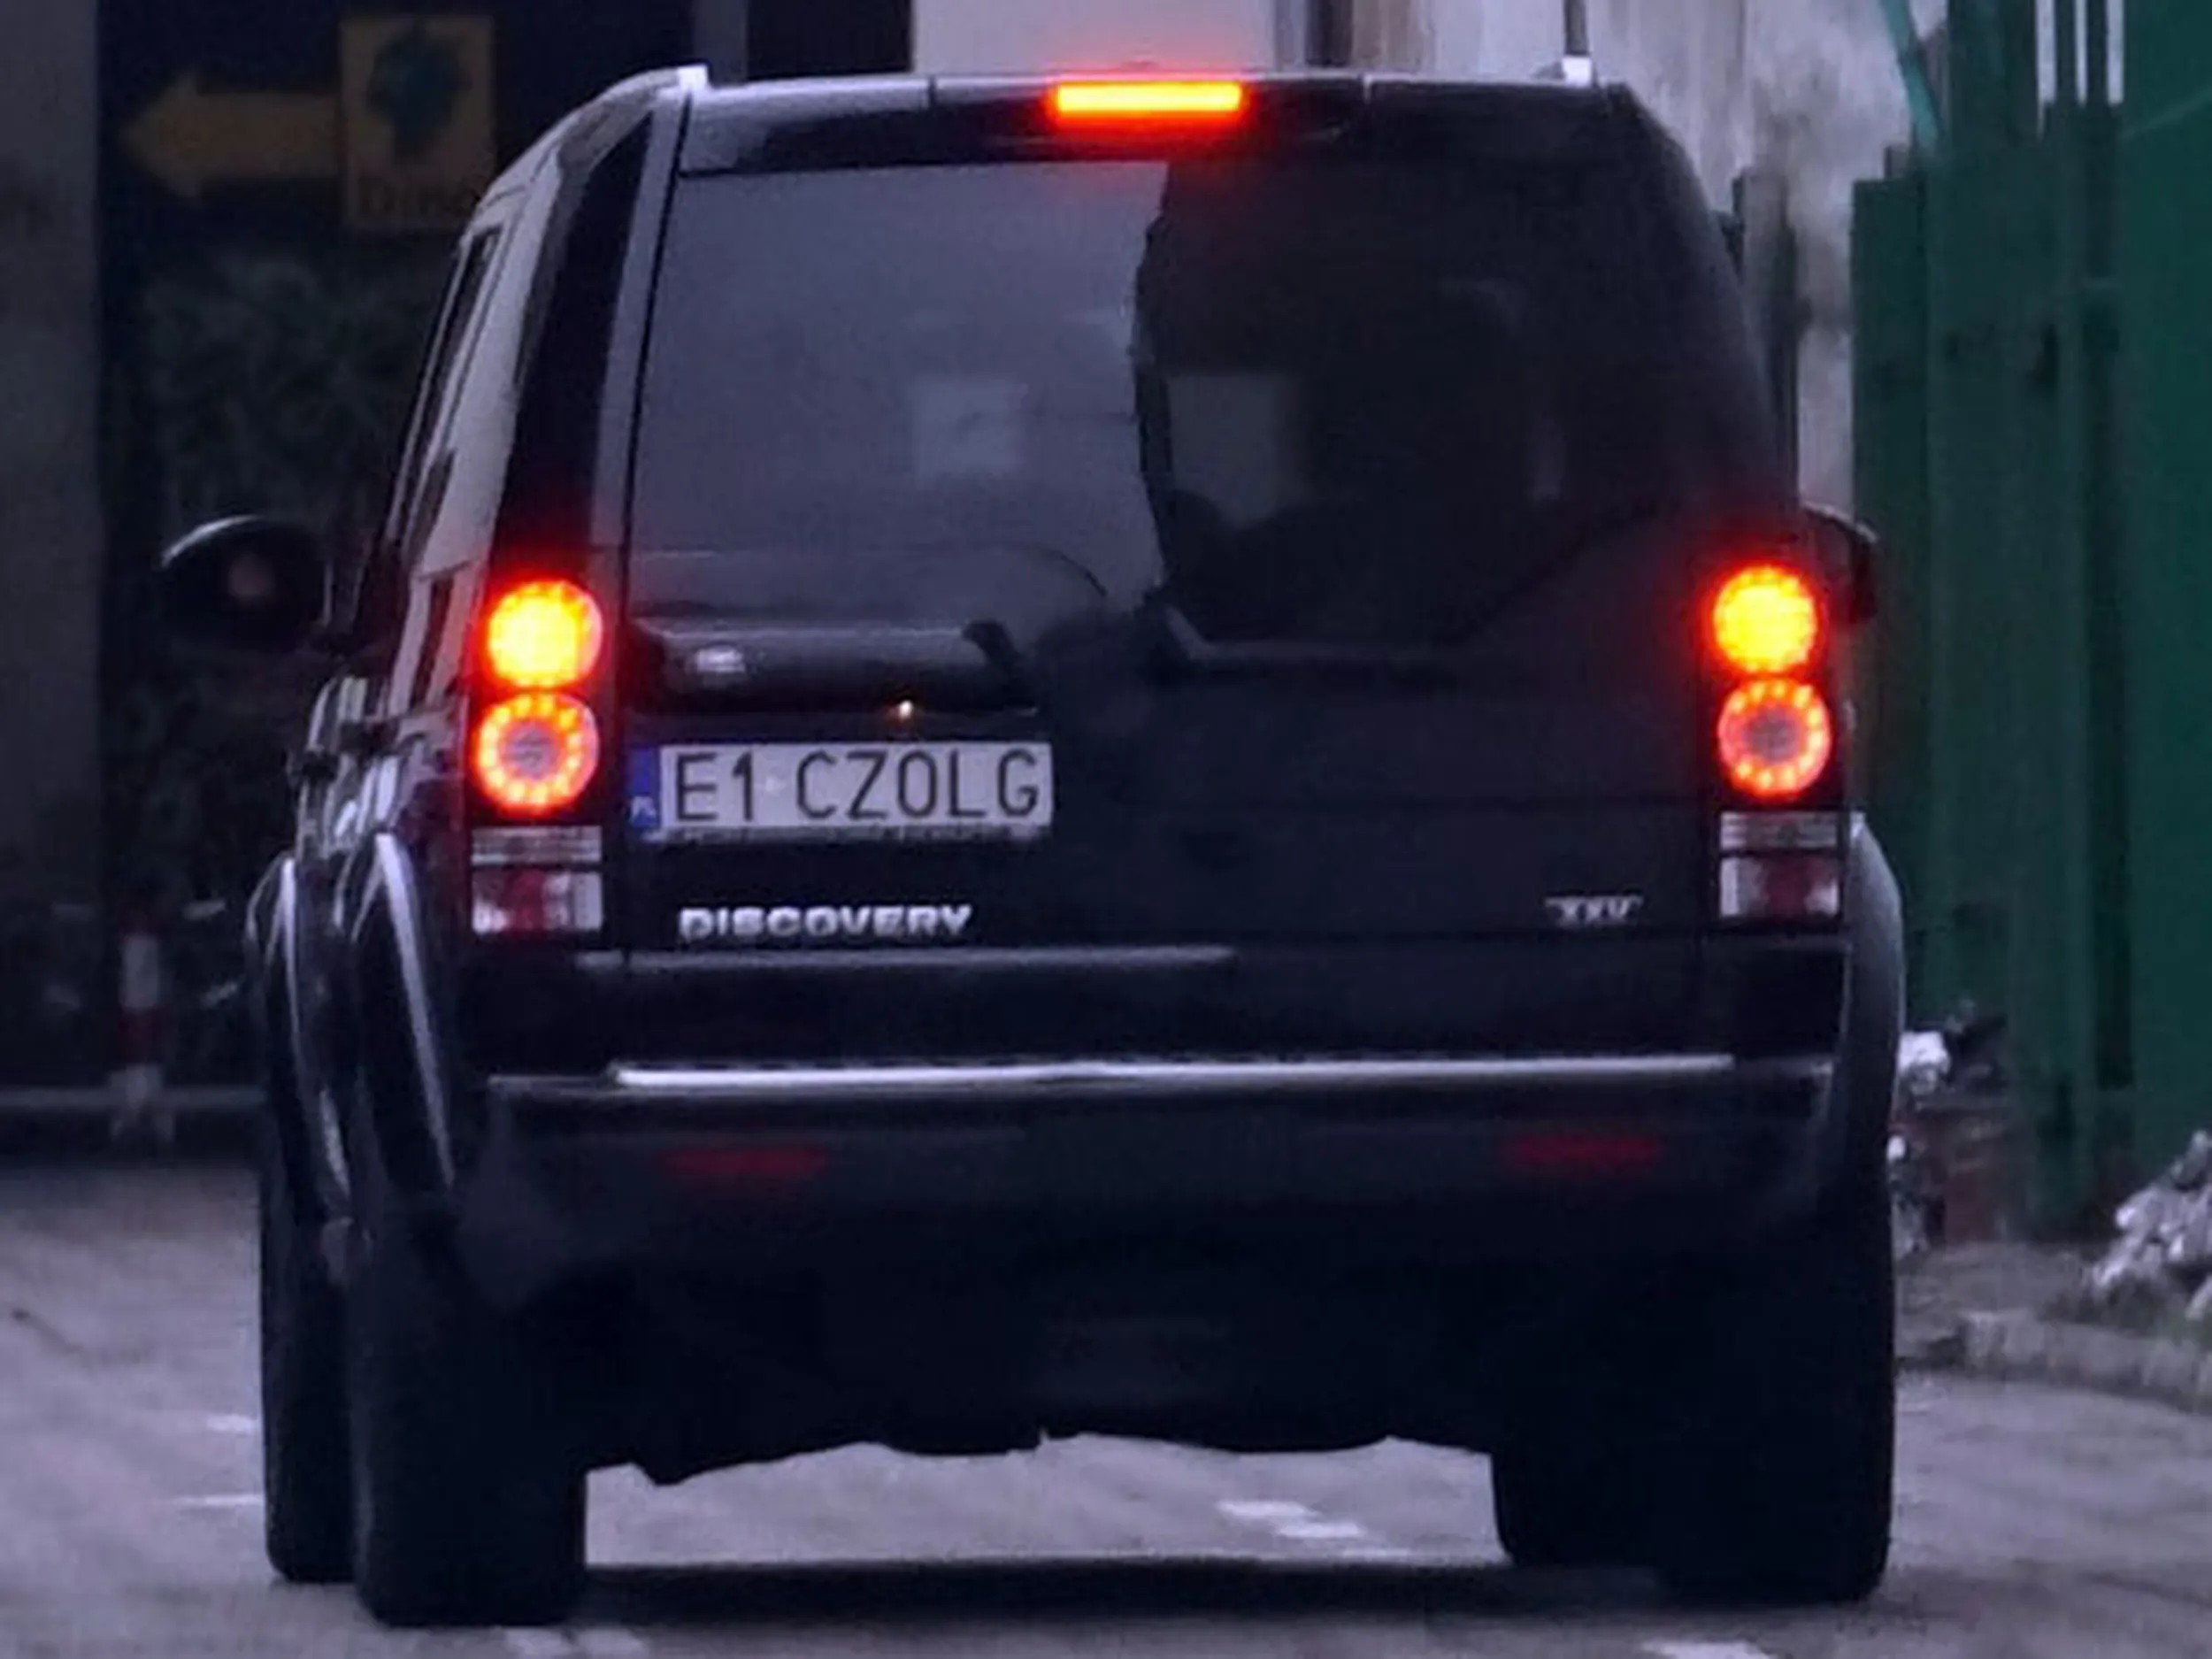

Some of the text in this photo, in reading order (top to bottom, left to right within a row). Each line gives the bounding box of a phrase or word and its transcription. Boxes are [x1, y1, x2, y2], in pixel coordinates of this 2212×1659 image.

[675, 749, 1039, 822] E1 CZOLG
[678, 904, 974, 939] DISCOVERY
